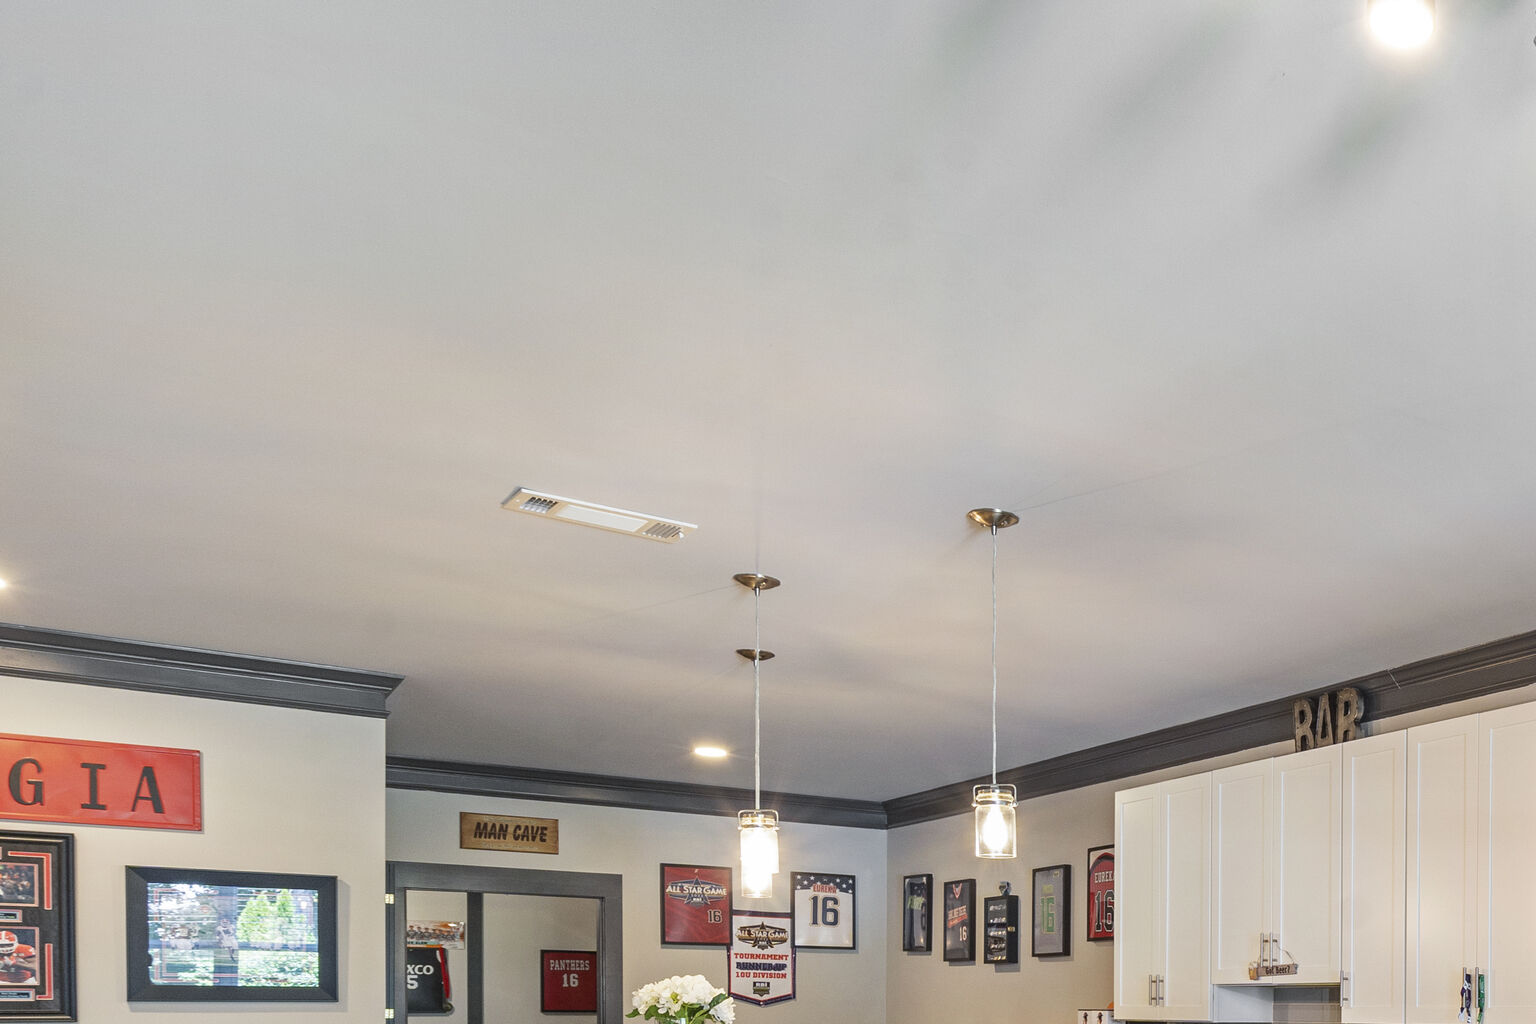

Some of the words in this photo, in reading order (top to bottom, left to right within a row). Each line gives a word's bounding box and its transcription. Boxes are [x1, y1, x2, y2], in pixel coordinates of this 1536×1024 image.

[1294, 688, 1364, 752] BAR
[8, 757, 165, 814] GIA
[474, 822, 508, 840] MAN
[513, 825, 548, 842] CAVE
[1094, 871, 1114, 884] EUREK
[703, 885, 727, 896] GAME
[707, 909, 723, 924] 16
[809, 894, 840, 928] 16
[1041, 896, 1056, 934] 16
[1094, 889, 1114, 933] 16
[959, 926, 968, 942] 16
[549, 959, 590, 971] PANTHERS
[734, 953, 789, 961] TOURNAMENT
[562, 973, 579, 988] 16
